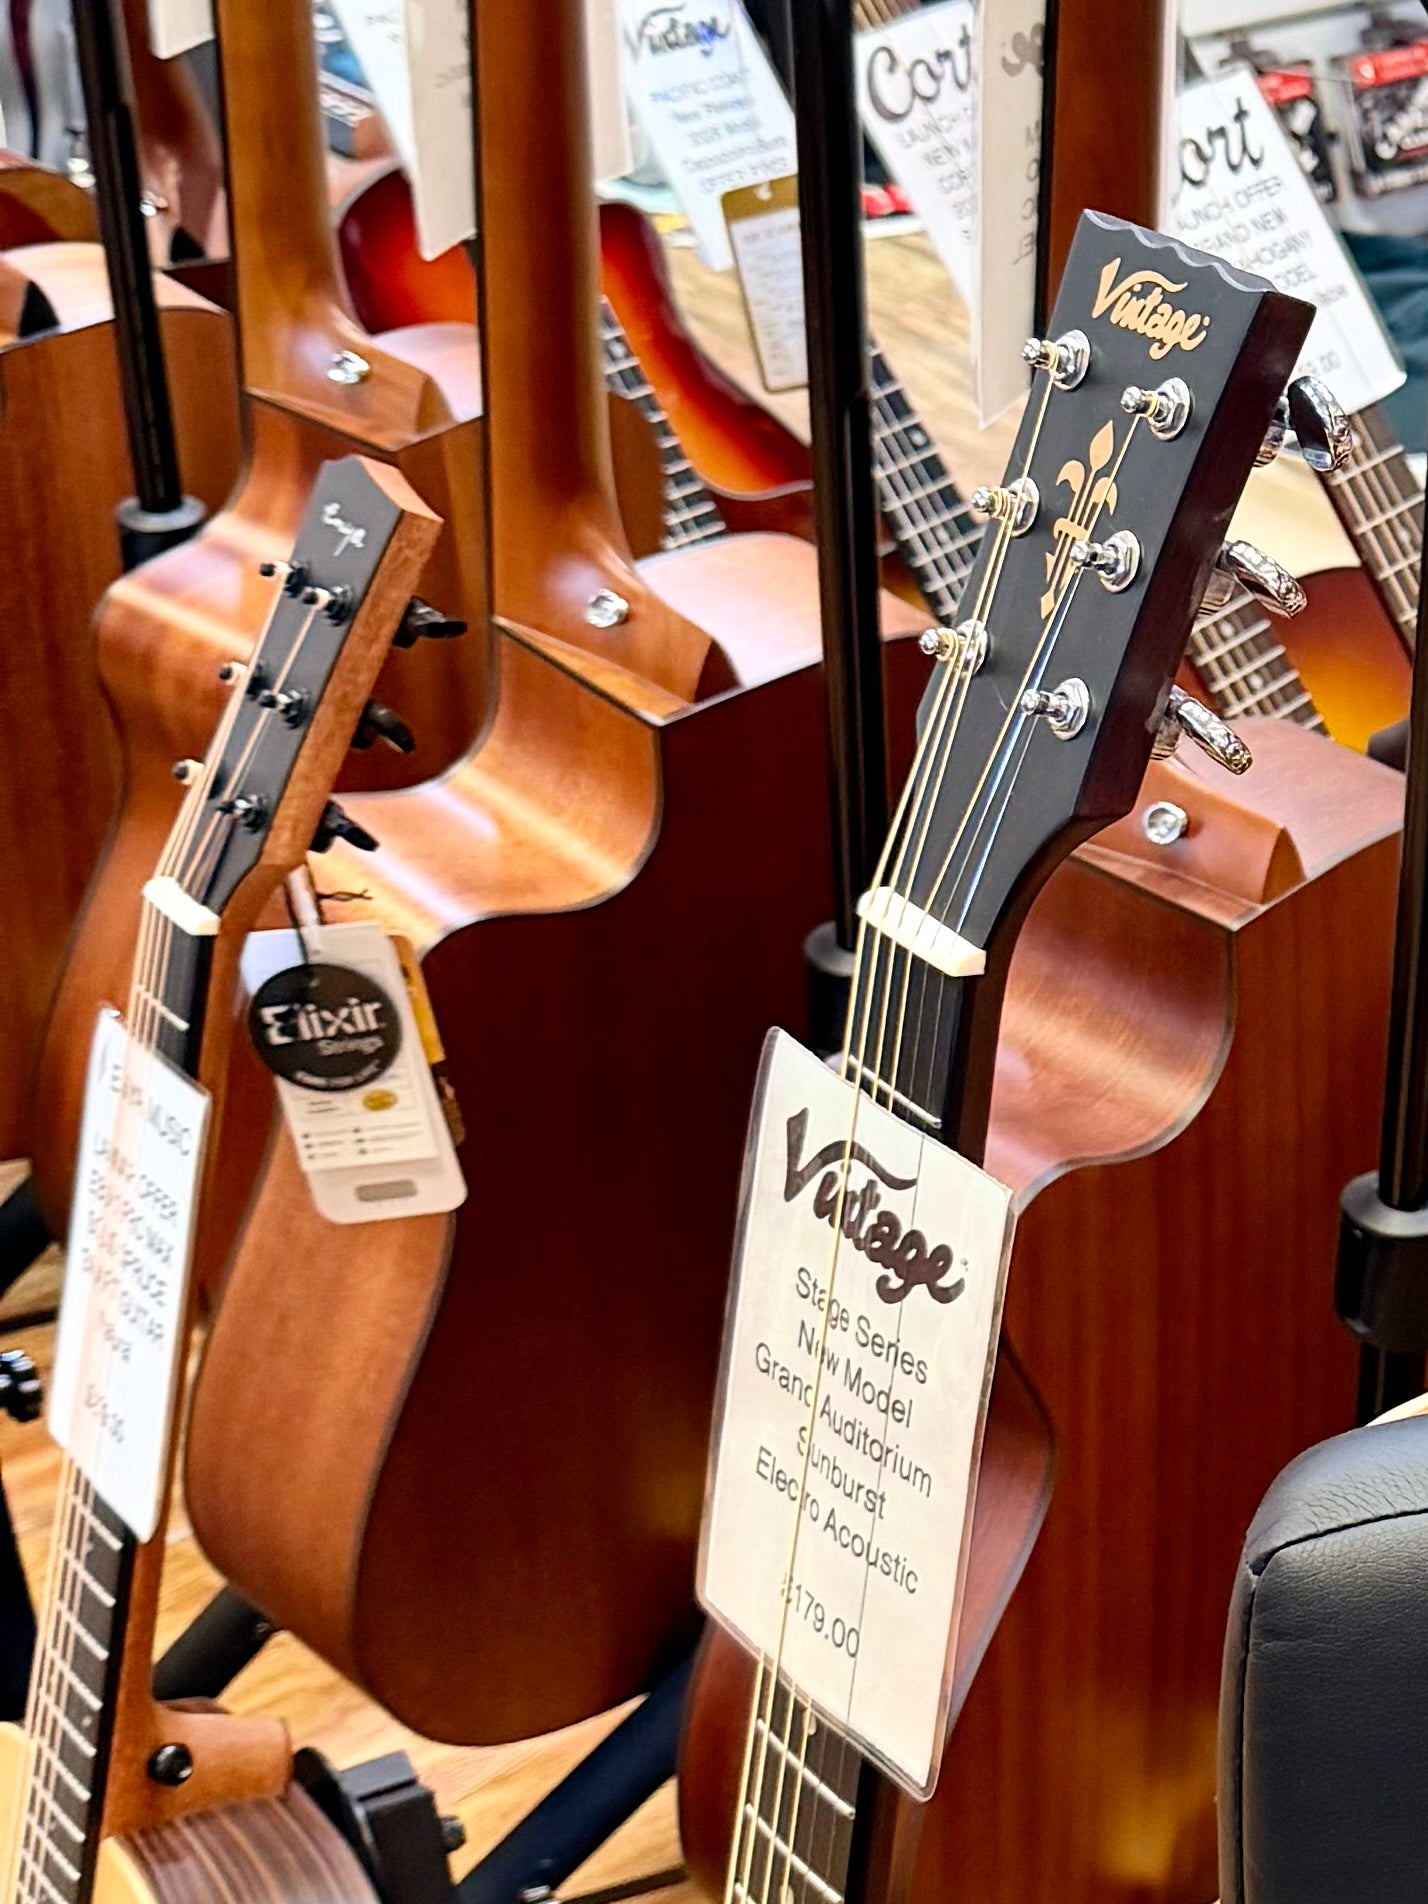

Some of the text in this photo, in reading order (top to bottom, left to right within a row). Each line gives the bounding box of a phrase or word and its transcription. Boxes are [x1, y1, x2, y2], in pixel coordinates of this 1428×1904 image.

[624, 3, 731, 64] Vintage
[868, 22, 972, 125] Cort
[1174, 97, 1265, 206] ort
[1091, 257, 1211, 360] Vintage
[1273, 263, 1318, 292] ODEL
[259, 997, 386, 1045] Elixir
[784, 1106, 966, 1305] Vintage
[795, 1266, 929, 1386] Stage Series
[843, 1356, 914, 1430] Model
[796, 1424, 887, 1521] Sunburst
[819, 1394, 934, 1499] Auditorium
[755, 1445, 919, 1595] Elecro Acoustic
